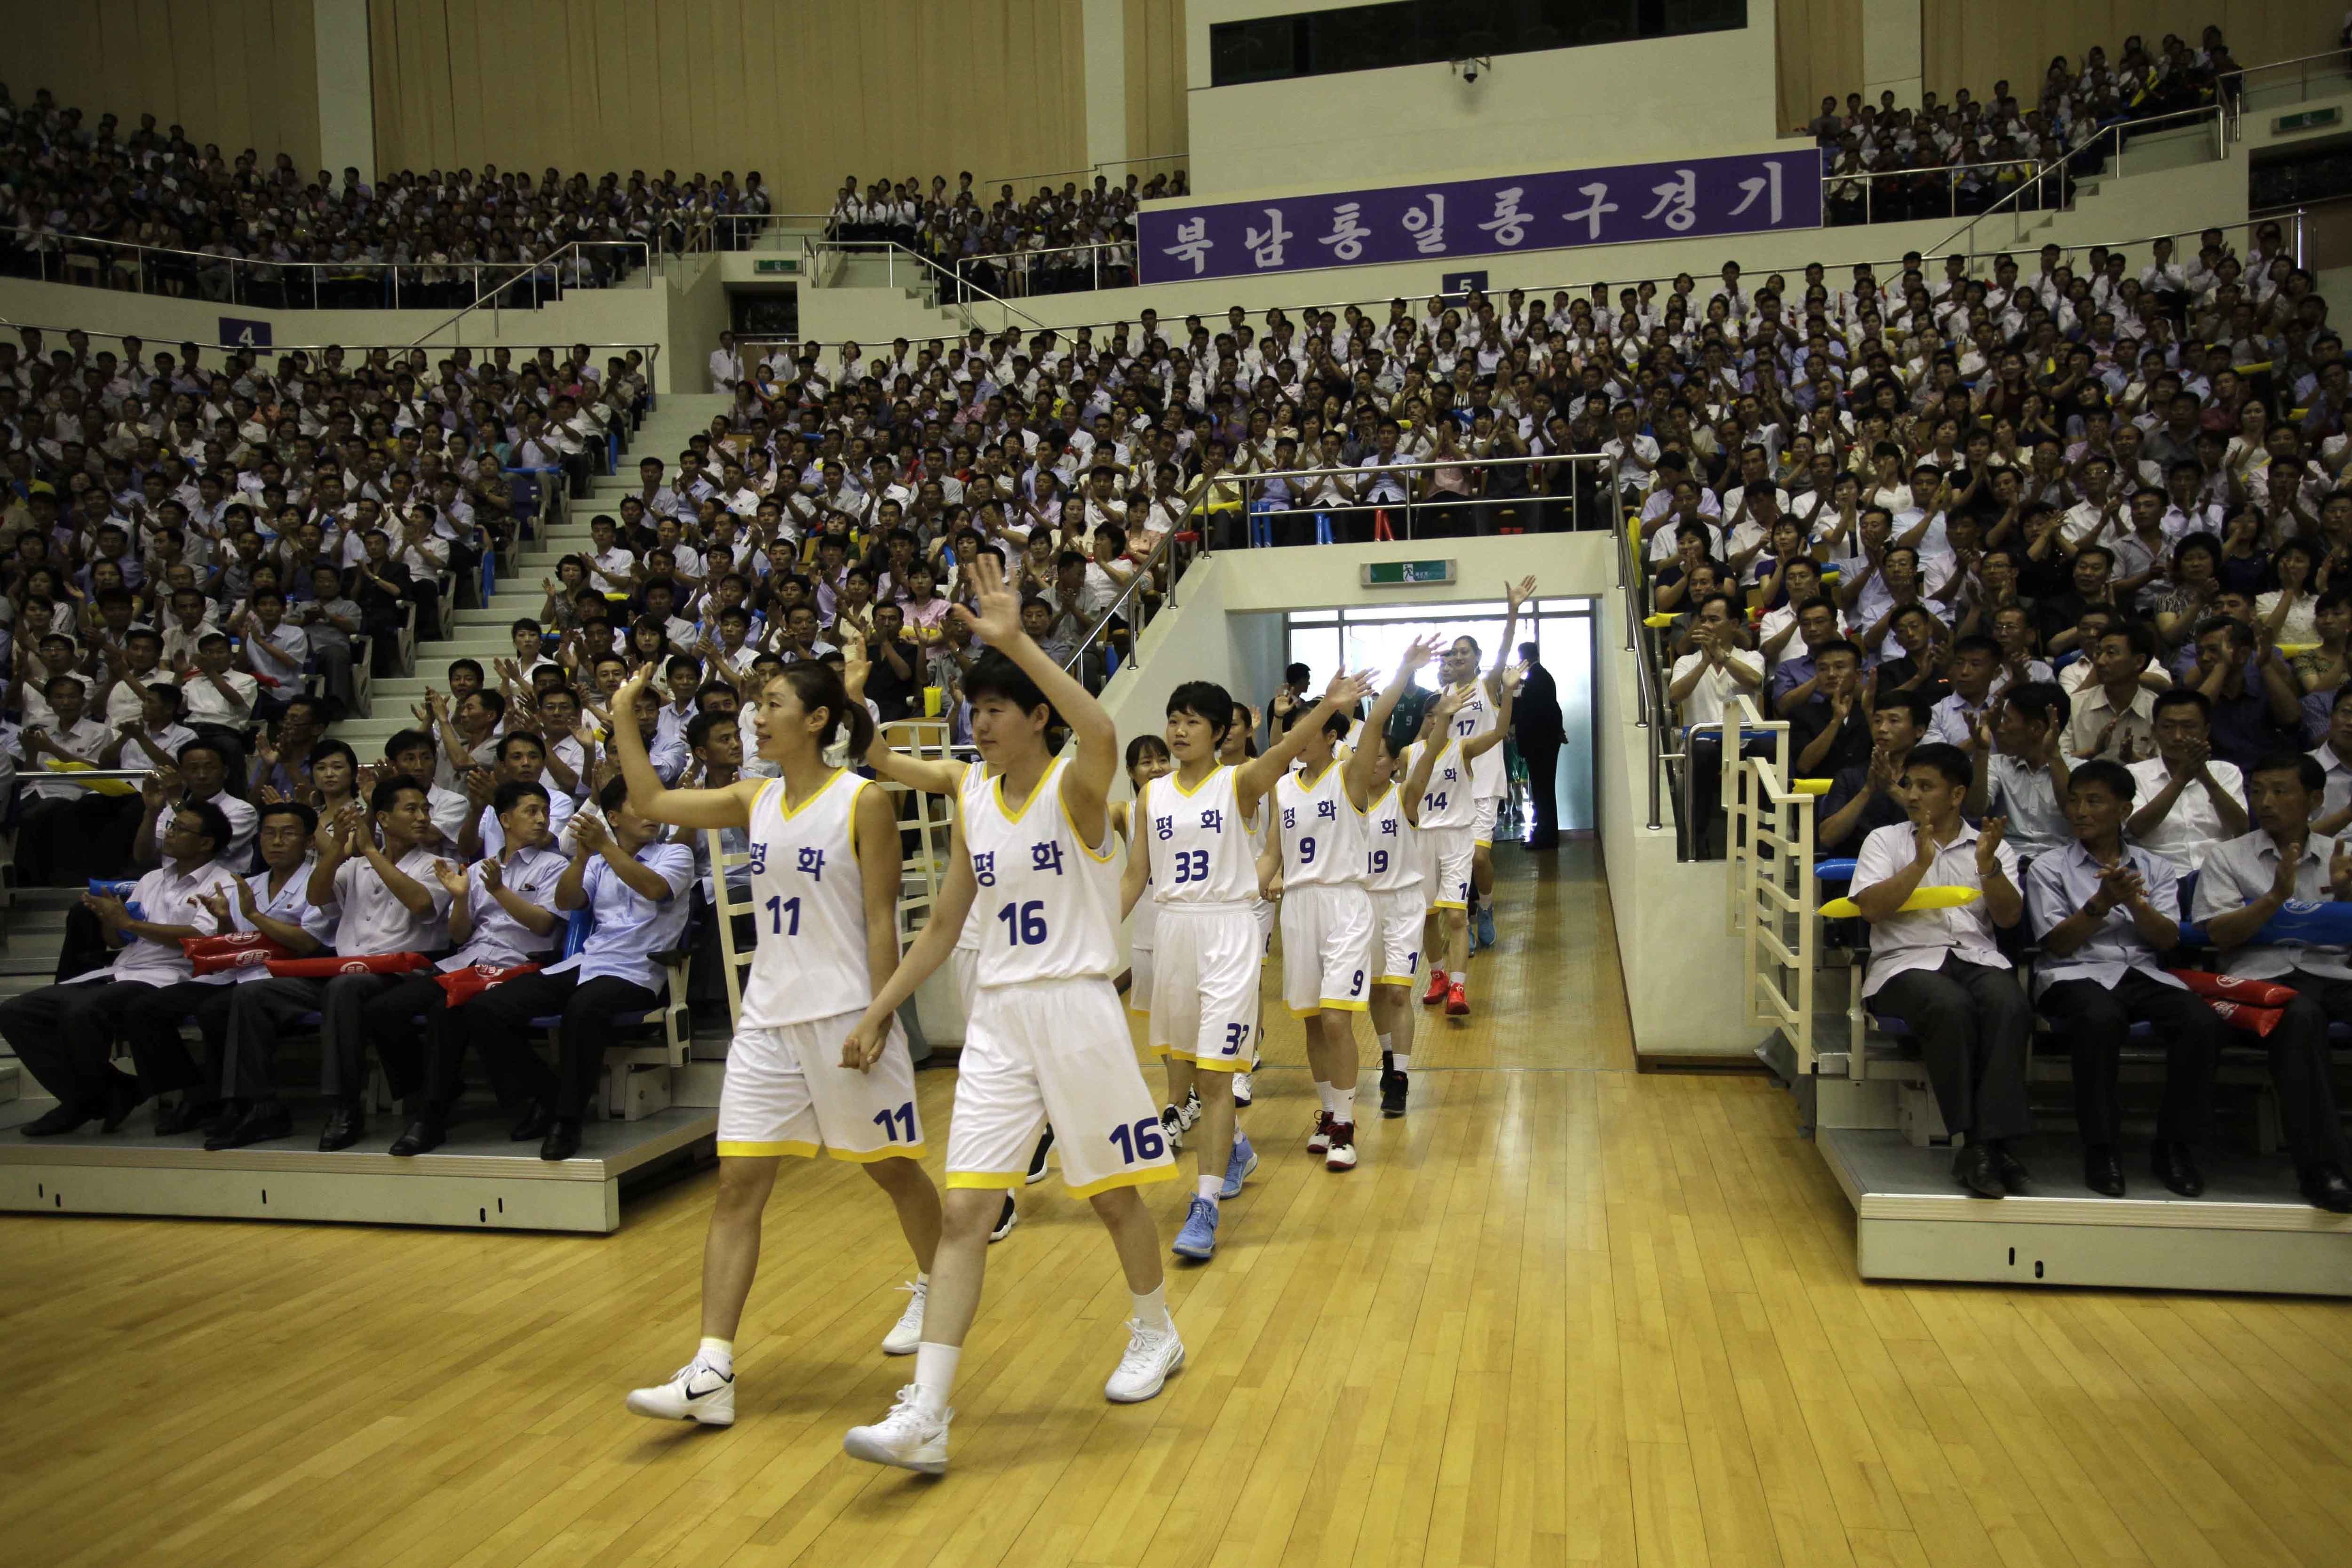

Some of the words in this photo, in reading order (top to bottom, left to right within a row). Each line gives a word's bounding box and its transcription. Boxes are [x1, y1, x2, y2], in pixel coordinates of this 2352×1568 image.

[1460, 279, 1472, 299] 5
[239, 327, 254, 347] 4
[1406, 716, 1413, 726] 9
[1456, 719, 1475, 736] 17
[1444, 767, 1457, 782] 화
[1317, 800, 1337, 821] 화
[1424, 792, 1447, 811] 14
[1156, 815, 1173, 841] 평
[1200, 809, 1223, 834] 화
[1381, 819, 1398, 837] 화
[973, 851, 996, 887] 평
[1031, 840, 1064, 876] 화
[1300, 837, 1316, 864] 9
[797, 847, 825, 882] 화
[1175, 850, 1209, 883] 33
[766, 895, 801, 936] 11
[997, 900, 1048, 946] 16
[1350, 970, 1364, 996] 9
[873, 1101, 916, 1143] 11
[1109, 1117, 1164, 1165] 16
